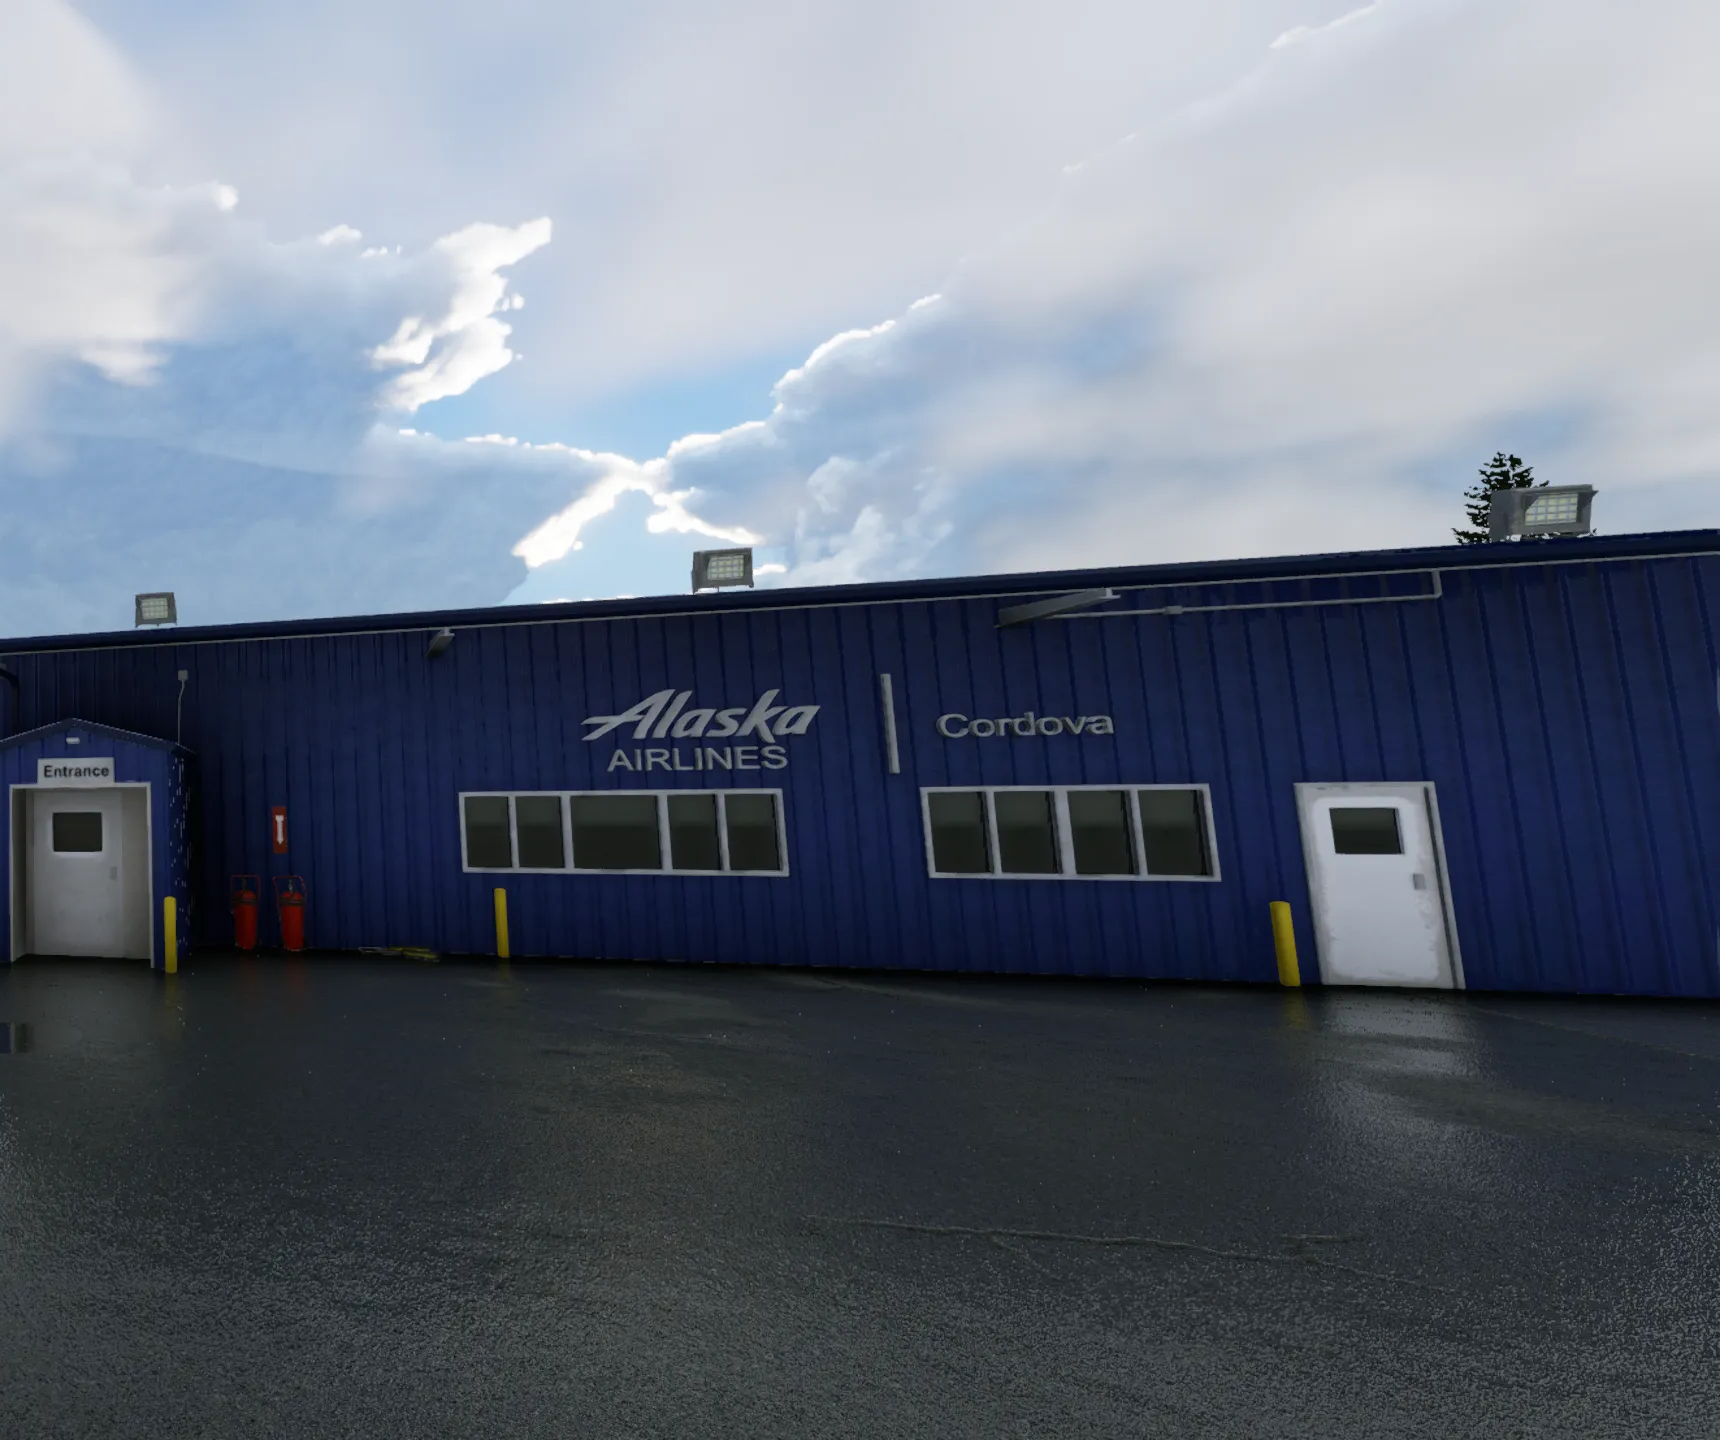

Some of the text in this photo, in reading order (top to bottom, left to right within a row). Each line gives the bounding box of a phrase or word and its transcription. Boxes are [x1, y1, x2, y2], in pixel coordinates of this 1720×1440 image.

[581, 688, 821, 743] Alaska
[936, 711, 1115, 738] Cordova
[43, 764, 110, 778] Entrance
[607, 746, 788, 772] AIRLINES
